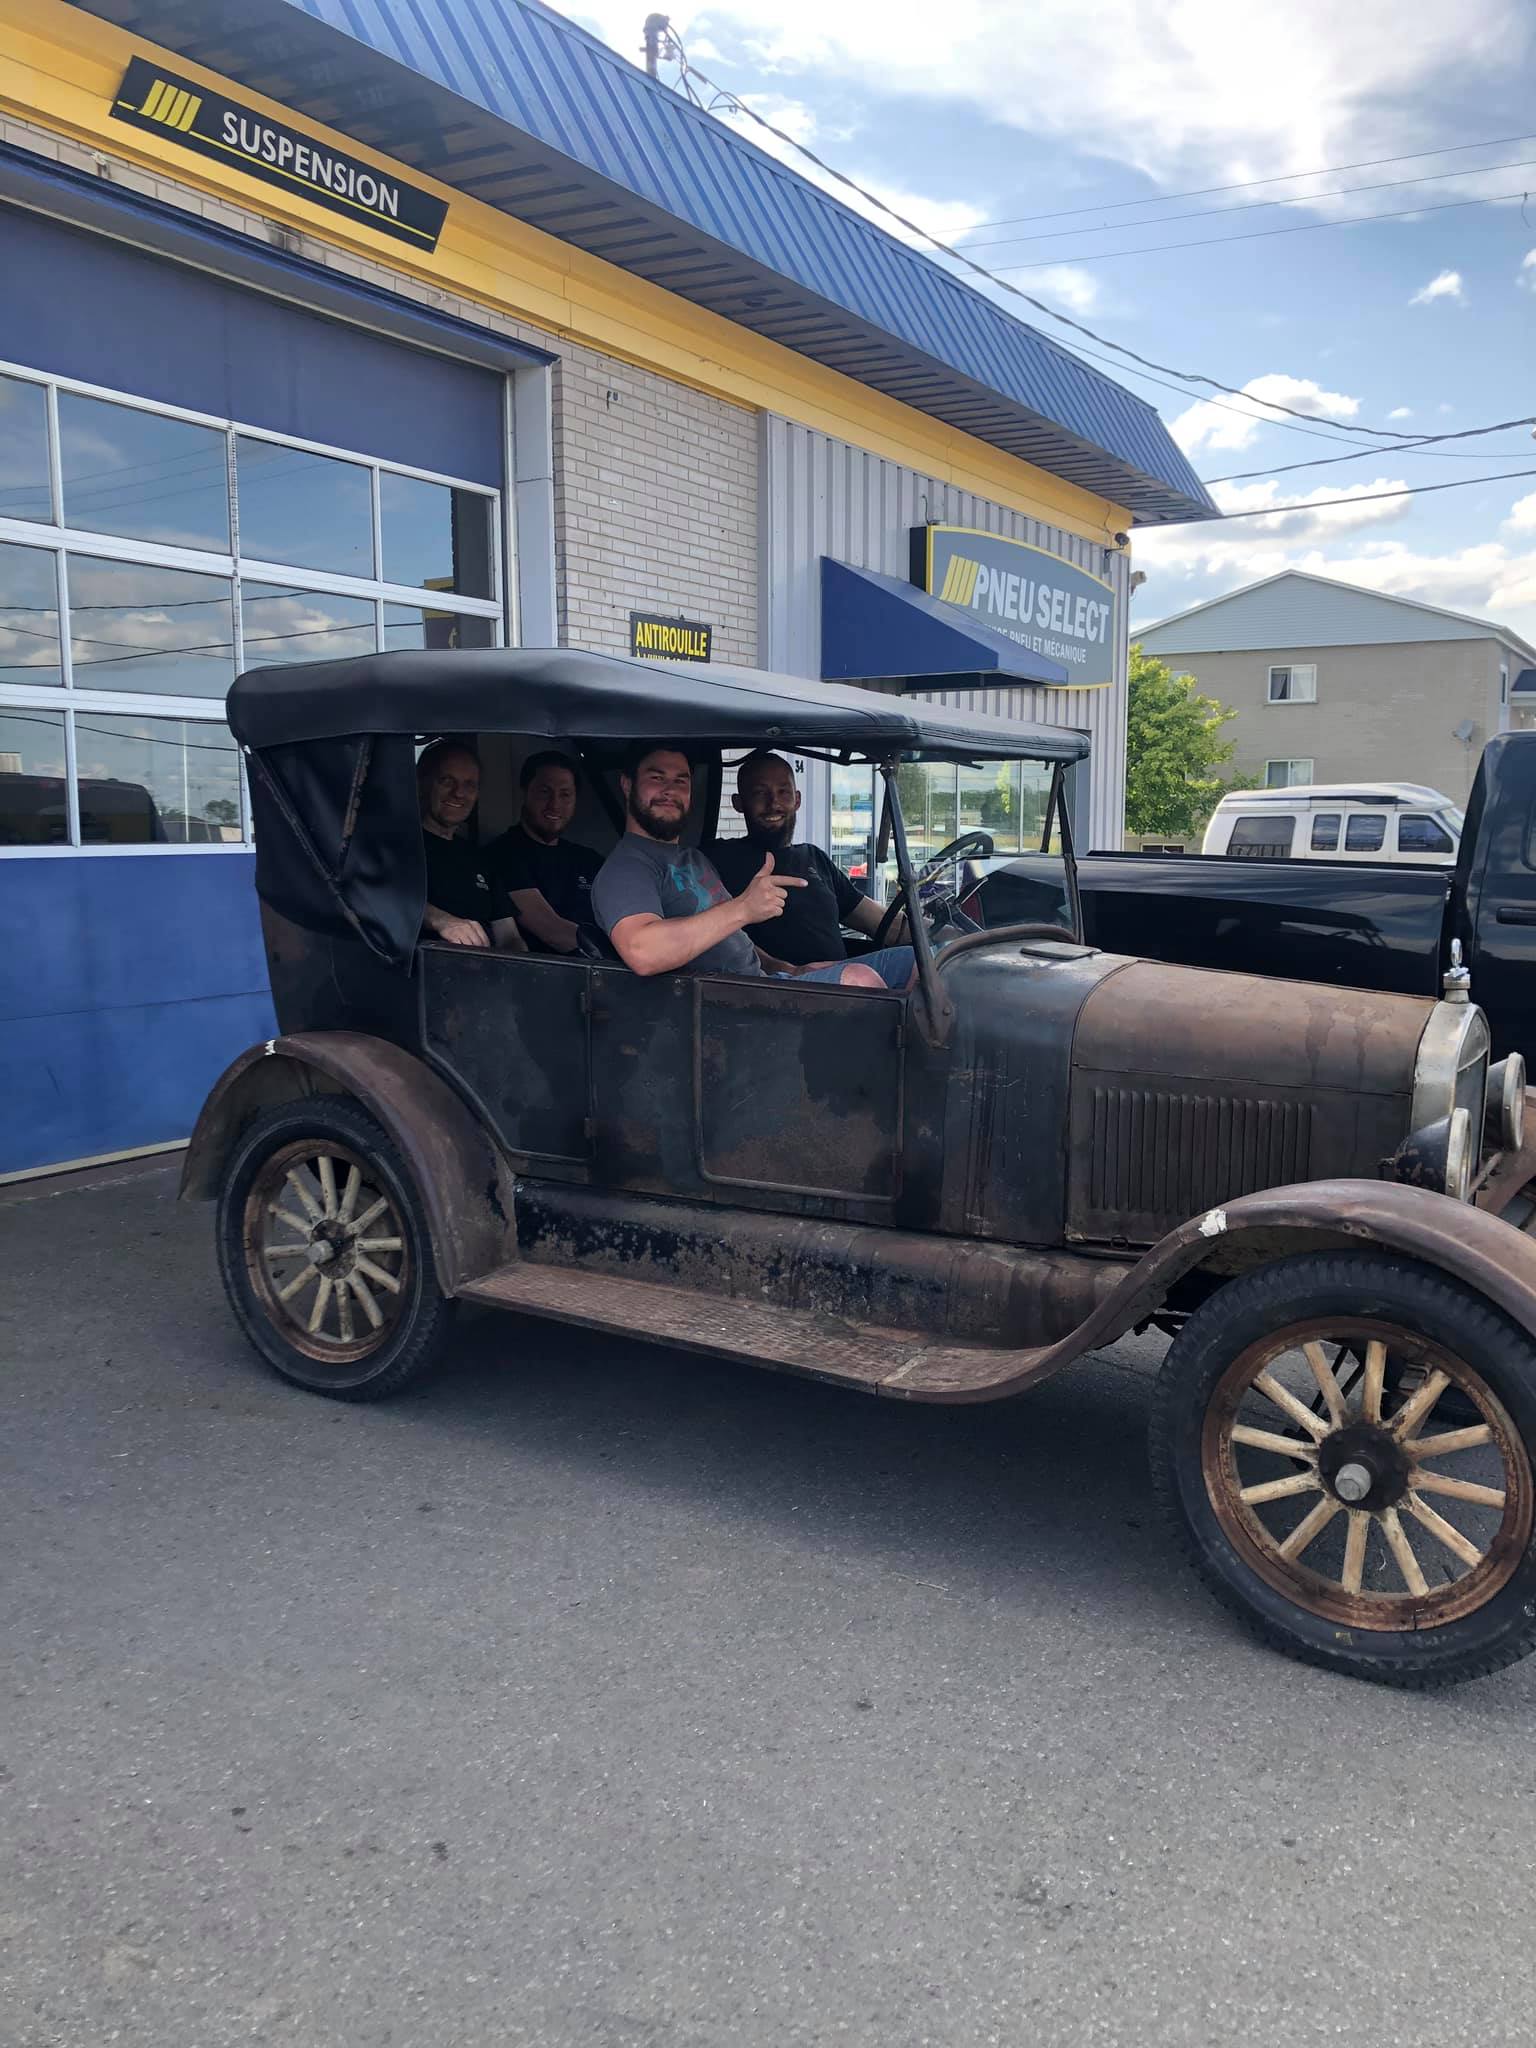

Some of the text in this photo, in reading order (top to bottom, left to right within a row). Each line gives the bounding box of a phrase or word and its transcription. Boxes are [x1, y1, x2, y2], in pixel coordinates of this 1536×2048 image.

[222, 110, 399, 217] SUSPENSION
[972, 564, 1110, 644] PNEU SELECT
[635, 621, 708, 657] ANTIROUILLE
[1032, 636, 1042, 654] ET
[1043, 637, 1087, 664] MÉCANIQUE
